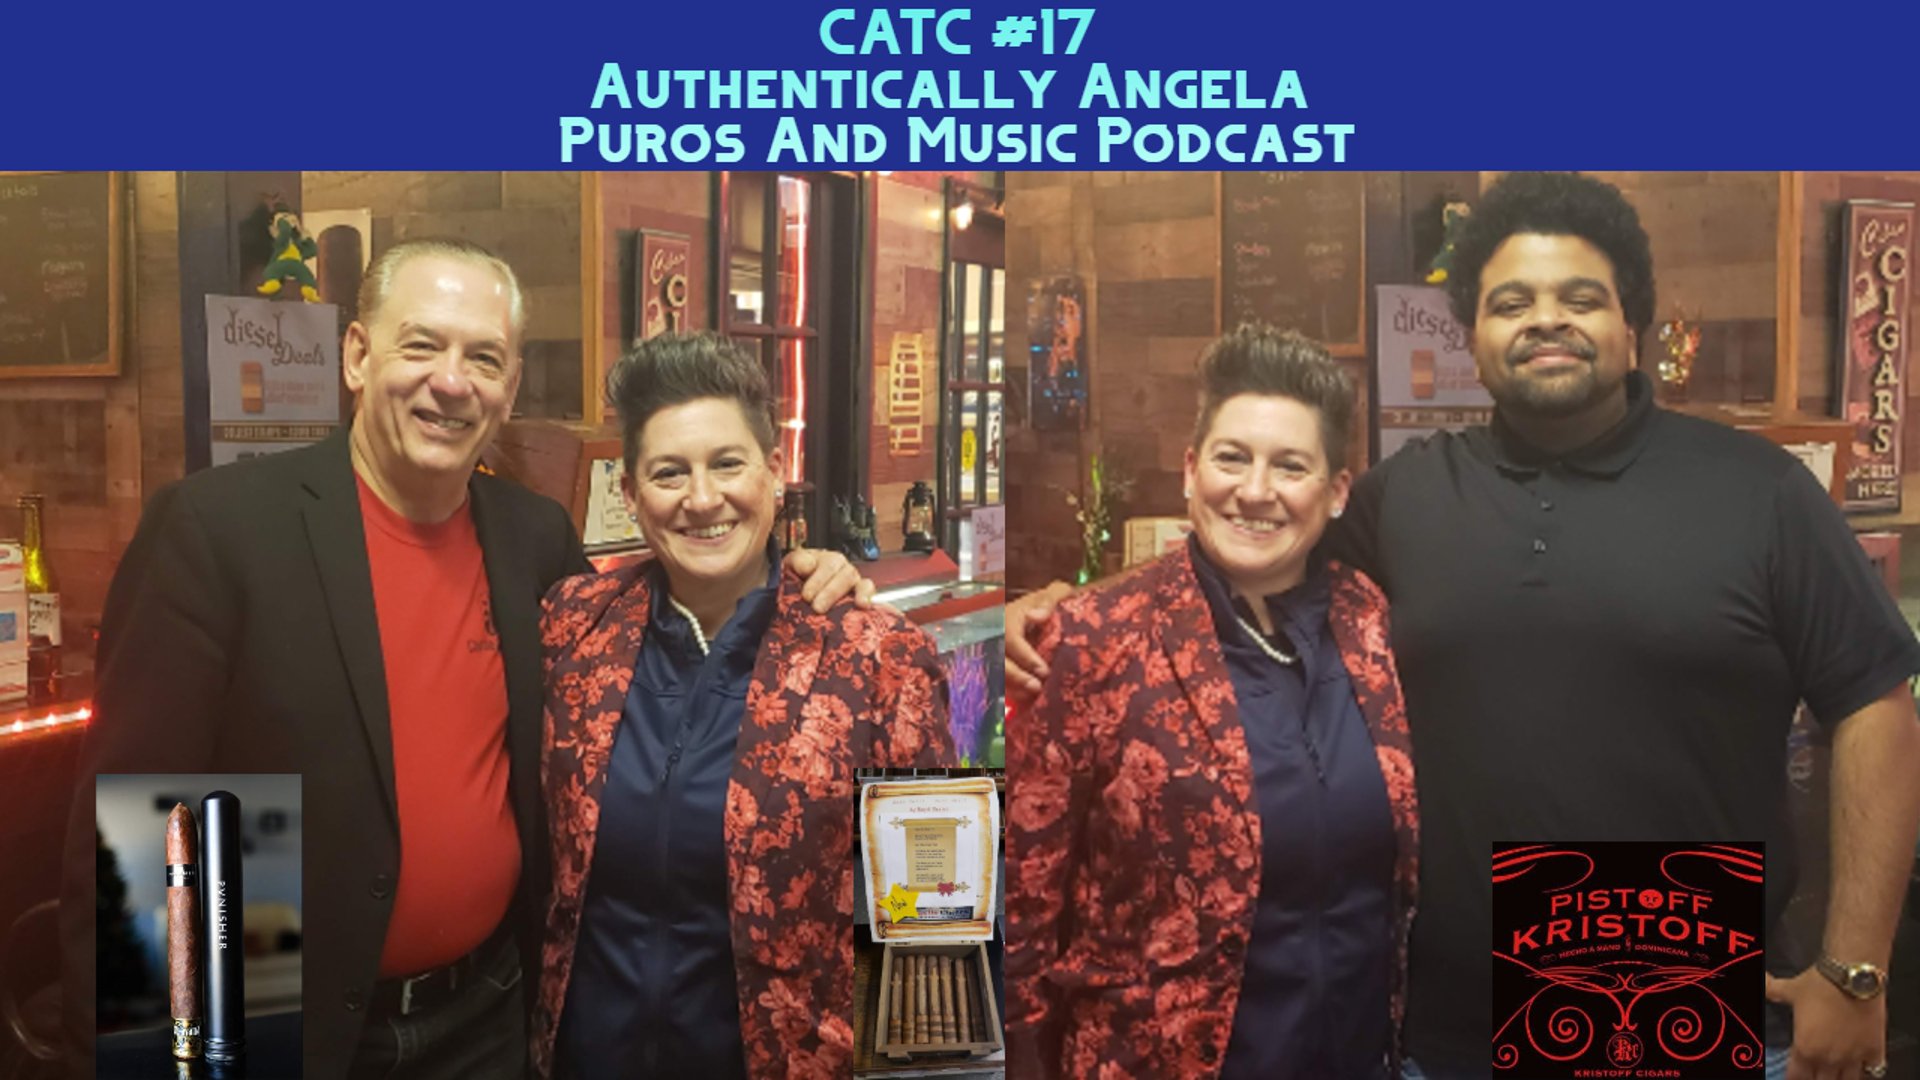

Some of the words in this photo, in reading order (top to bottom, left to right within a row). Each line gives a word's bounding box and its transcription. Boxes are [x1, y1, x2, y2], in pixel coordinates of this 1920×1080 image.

[223, 306, 285, 350] diesel
[1874, 245, 1906, 453] CIGARS
[1512, 913, 1756, 955] KRISTOFF
[1558, 946, 1587, 960] HECHO
[1634, 944, 1690, 958] DOMINICANA
[1574, 1069, 1632, 1078] KRISTOFF
[1635, 1069, 1680, 1078] CIGARS
